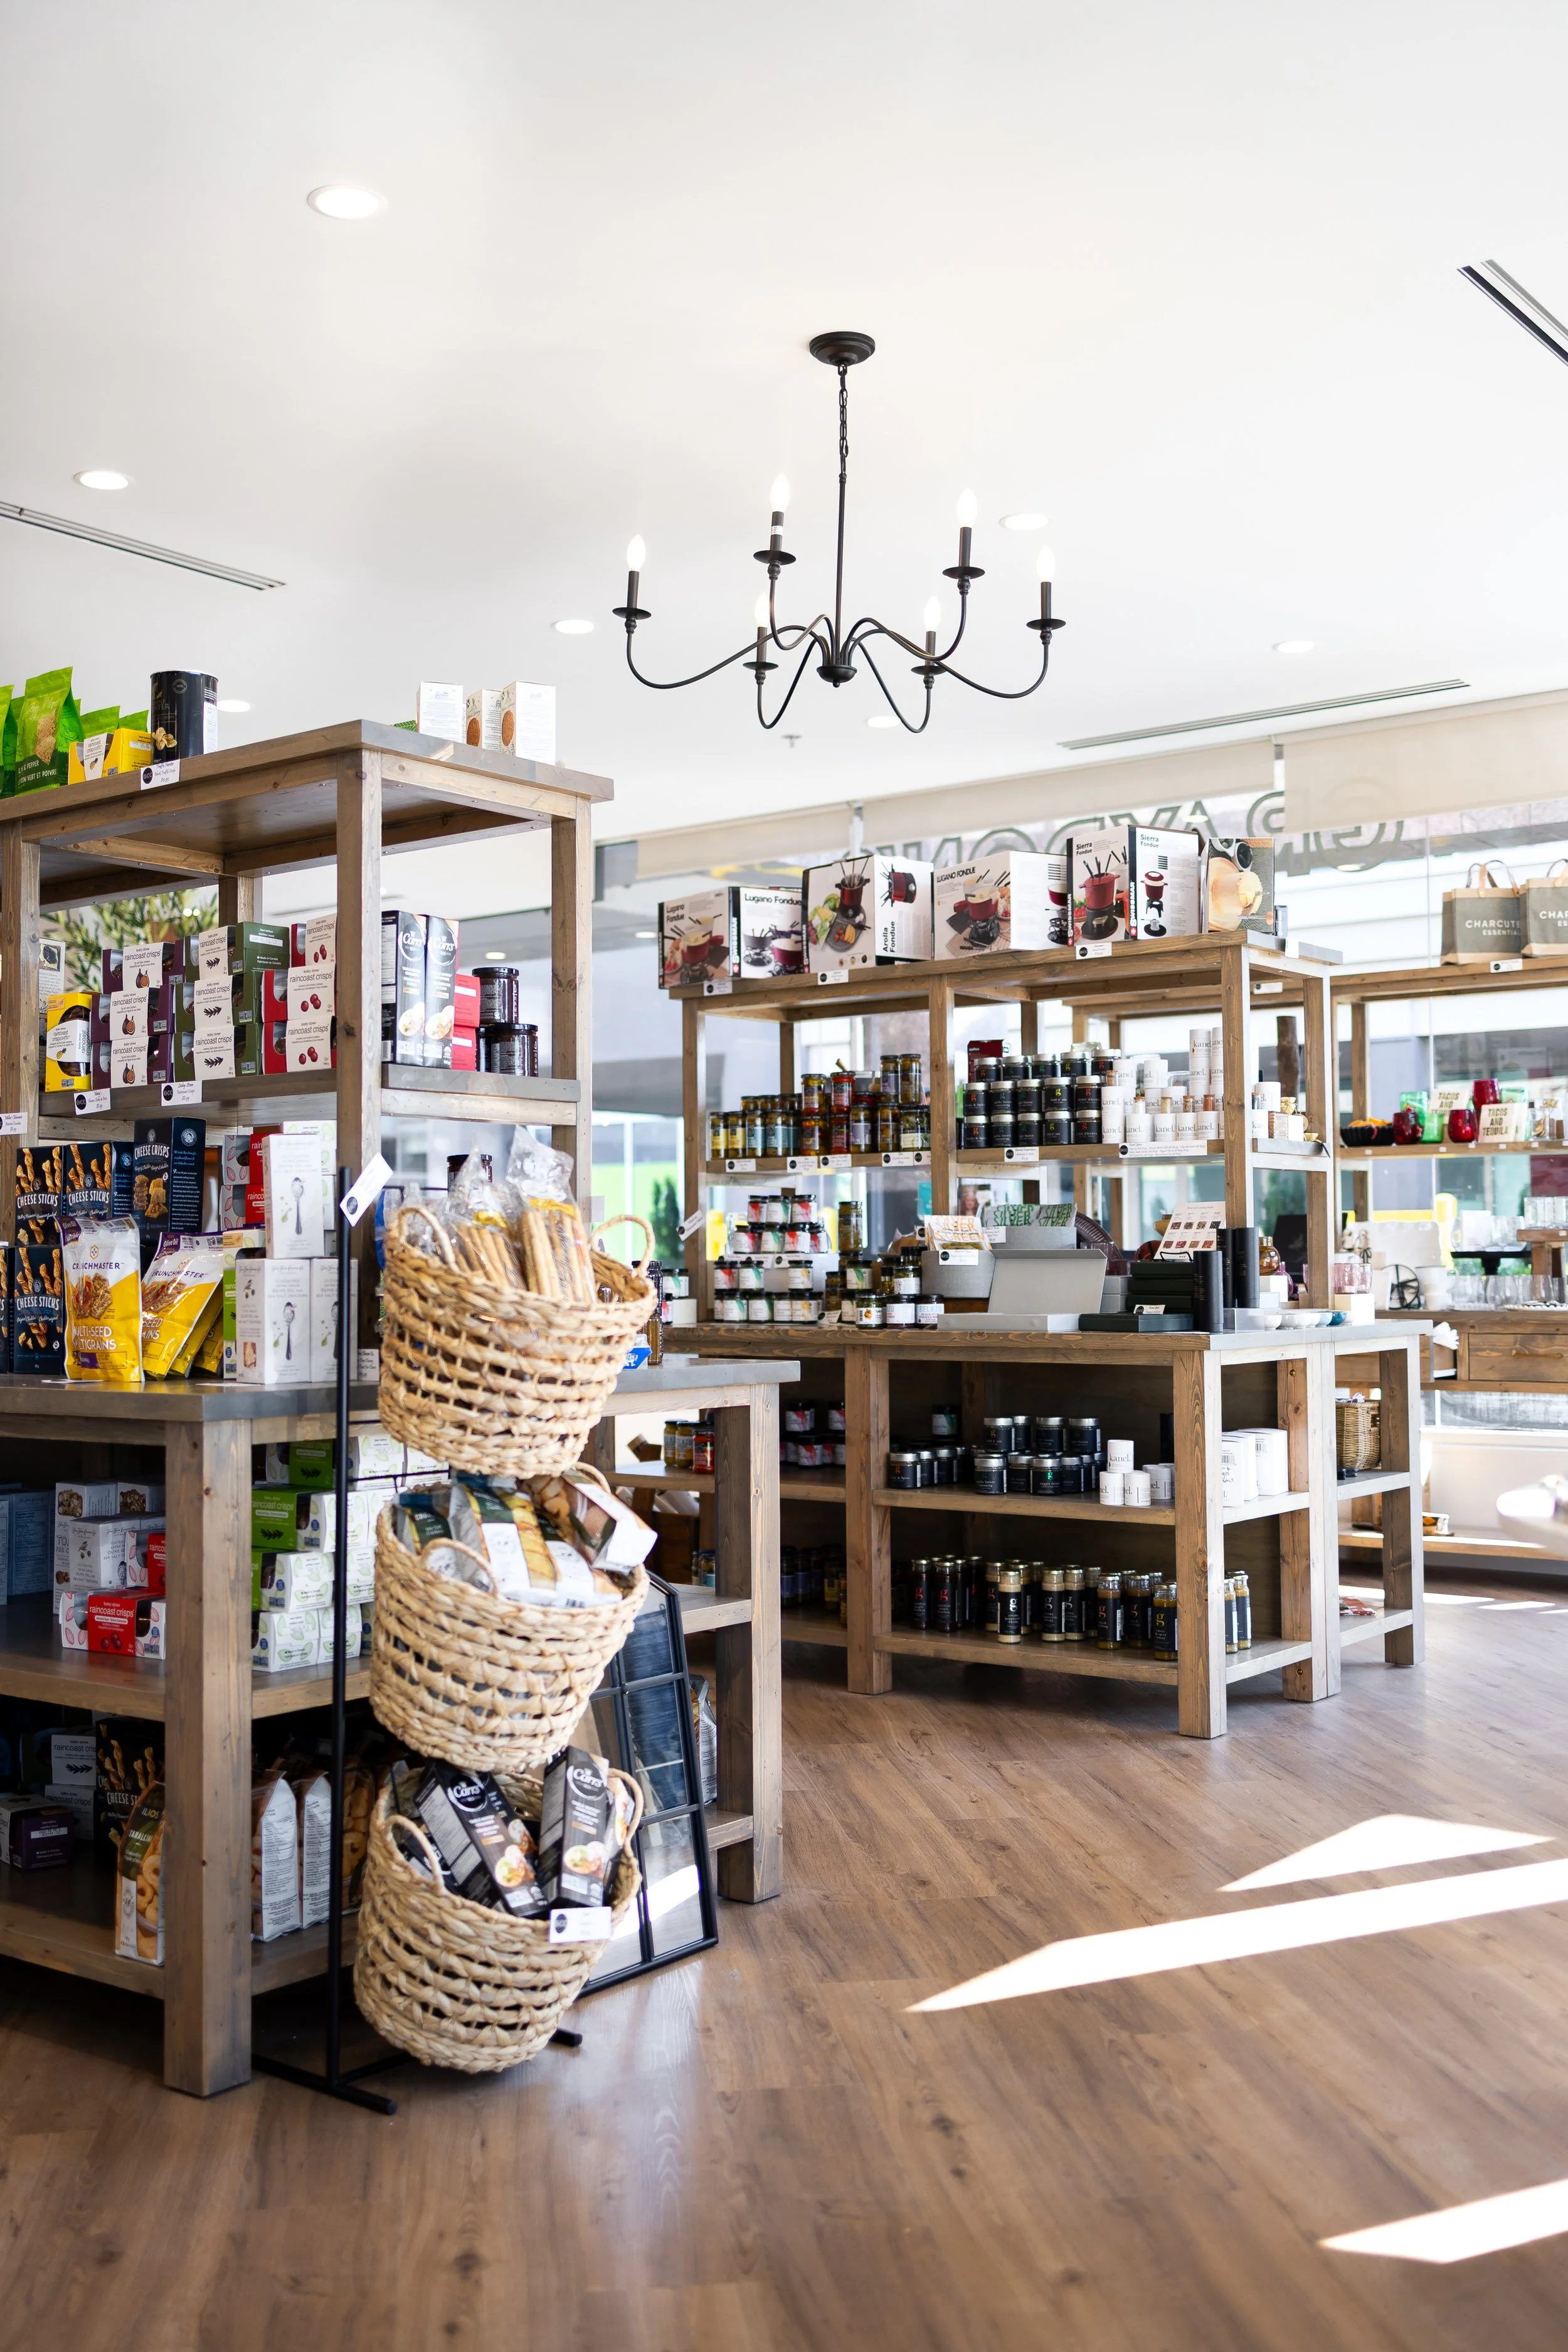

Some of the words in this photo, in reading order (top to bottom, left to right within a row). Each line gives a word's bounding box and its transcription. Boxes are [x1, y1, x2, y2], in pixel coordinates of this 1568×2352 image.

[27, 760, 39, 770] PEPPER
[28, 773, 36, 781] VERT
[42, 769, 57, 778] POIVRE
[1140, 834, 1159, 842] Sierra
[1076, 841, 1093, 850] Sierra
[936, 870, 957, 883] LUGANO
[957, 866, 976, 878] FONDUE
[744, 893, 773, 904] Lugano
[774, 896, 802, 905] Fondue
[666, 904, 685, 914] Lugano
[666, 913, 685, 923] Fondue
[307, 926, 324, 935] raincoast
[324, 922, 335, 931] crisps
[199, 937, 215, 948] raincoast
[215, 935, 226, 945] crisps
[125, 951, 145, 961] raincoast
[146, 950, 161, 959] crisps
[290, 974, 315, 983] raincoast
[315, 972, 333, 980] crisps
[196, 987, 216, 996] raincoast
[216, 985, 231, 994] crisps
[112, 997, 132, 1006] raincoast
[133, 995, 147, 1005] crisps
[288, 1027, 312, 1036] raincoast
[312, 1024, 329, 1034] crisps
[196, 1037, 217, 1046] raincoast
[218, 1036, 232, 1044] crisps
[113, 1046, 132, 1055] raincoast
[133, 1044, 147, 1053] crisps
[1056, 1088, 1061, 1096] g
[1086, 1088, 1091, 1096] g
[1439, 1092, 1459, 1100] TACOS
[971, 1094, 977, 1102] g
[1103, 1098, 1121, 1106] kanel.
[1488, 1108, 1508, 1116] TACOS
[1082, 1123, 1088, 1131] g
[1103, 1126, 1122, 1134] kanel.
[1178, 1124, 1197, 1132] kanel.
[1483, 1127, 1508, 1136] TEQUILA
[134, 1145, 151, 1160] CHEESE
[152, 1145, 169, 1158] CRISPS
[17, 1194, 36, 1209] CHEESE
[38, 1194, 58, 1207] STICKS
[68, 1191, 88, 1206] CHEESE
[90, 1190, 110, 1204] STICKS
[16, 1296, 38, 1310] CHEESE
[39, 1298, 60, 1310] STICKS
[1109, 1453, 1130, 1463] kanel.
[1048, 1471, 1053, 1481] g
[277, 1503, 294, 1511] crisps
[149, 1543, 166, 1552] raincoa
[915, 1587, 923, 1601] g
[940, 1589, 948, 1602] g
[1010, 1598, 1017, 1612] g
[1045, 1597, 1053, 1610] g
[90, 1606, 115, 1615] raincoast
[116, 1608, 134, 1618] crisps
[1099, 1606, 1106, 1618] g
[1131, 1604, 1138, 1616] g
[1156, 1613, 1165, 1628] g
[54, 1744, 84, 1752] raincoast
[46, 1795, 75, 1804] raincoast
[107, 1793, 129, 1804] CHEESE
[129, 1830, 153, 1842] TARALLINI
